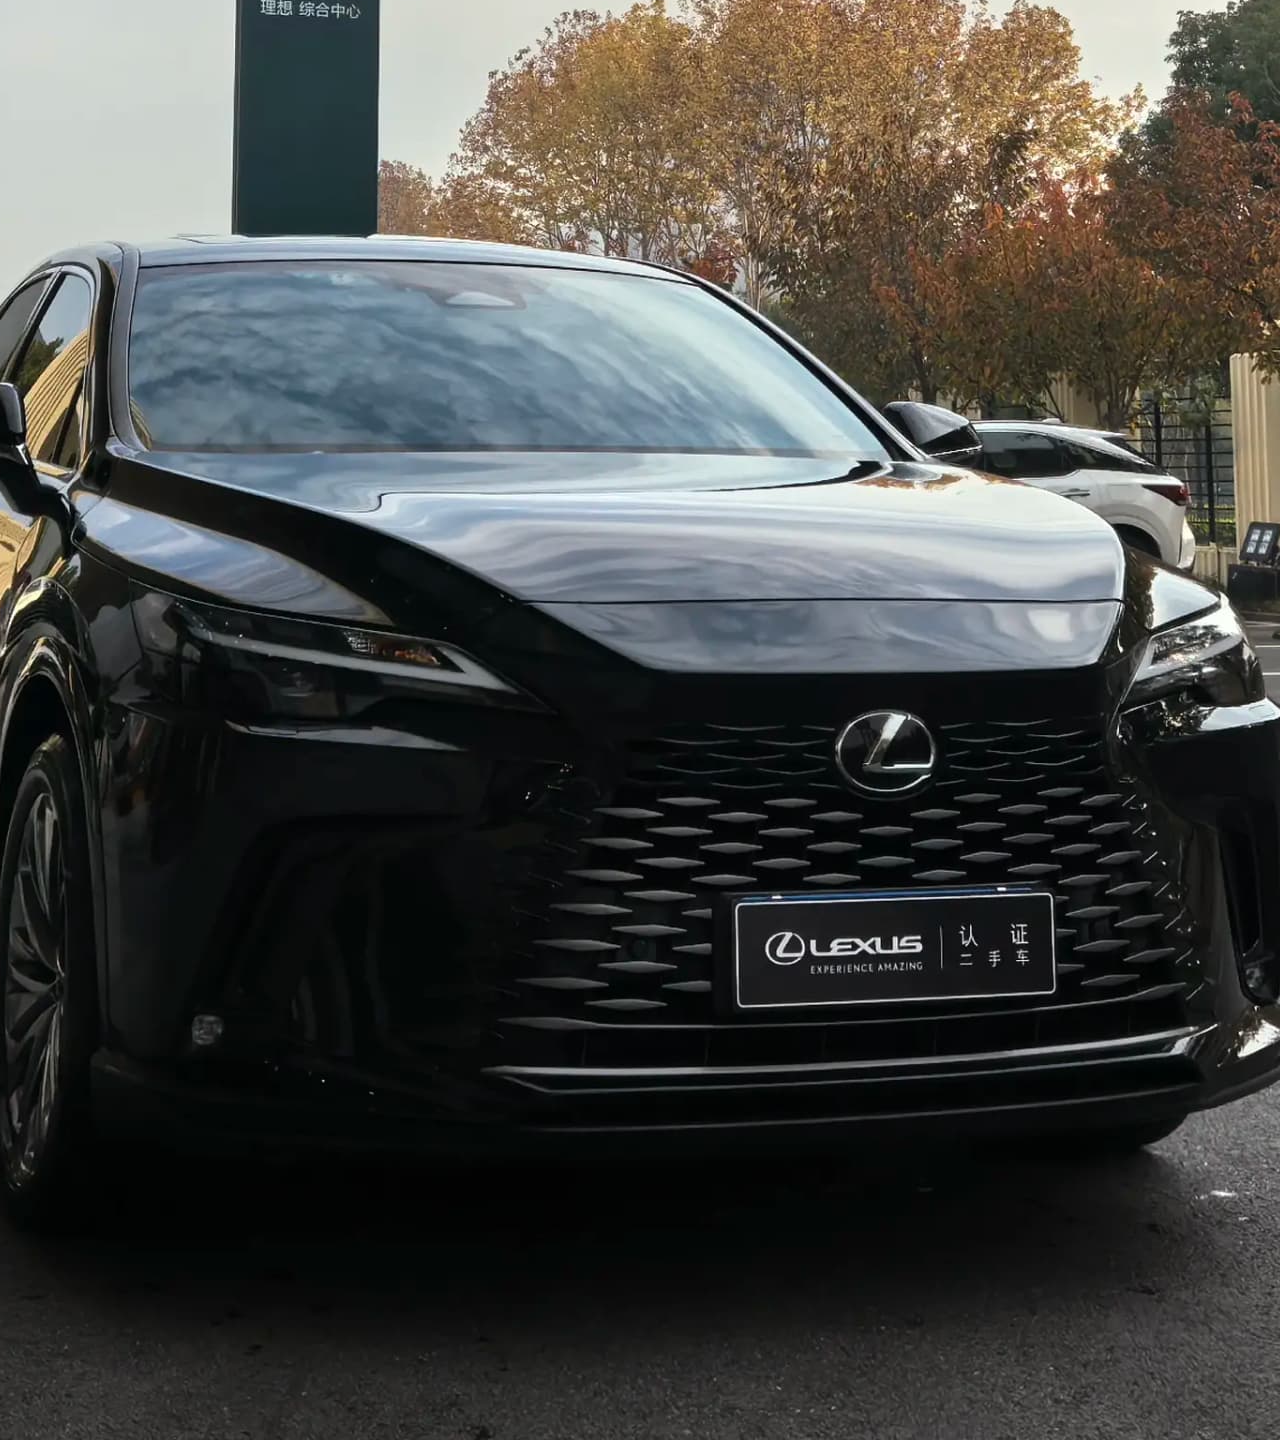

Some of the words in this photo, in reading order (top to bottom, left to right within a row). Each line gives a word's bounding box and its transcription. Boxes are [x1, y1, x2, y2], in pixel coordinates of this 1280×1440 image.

[260, 0, 293, 16] 理想
[299, 1, 361, 19] 综合中心
[959, 923, 1029, 947] 认证
[810, 936, 923, 956] LEXUS
[810, 963, 874, 975] EXPERIENCE
[877, 961, 924, 972] AMAZING
